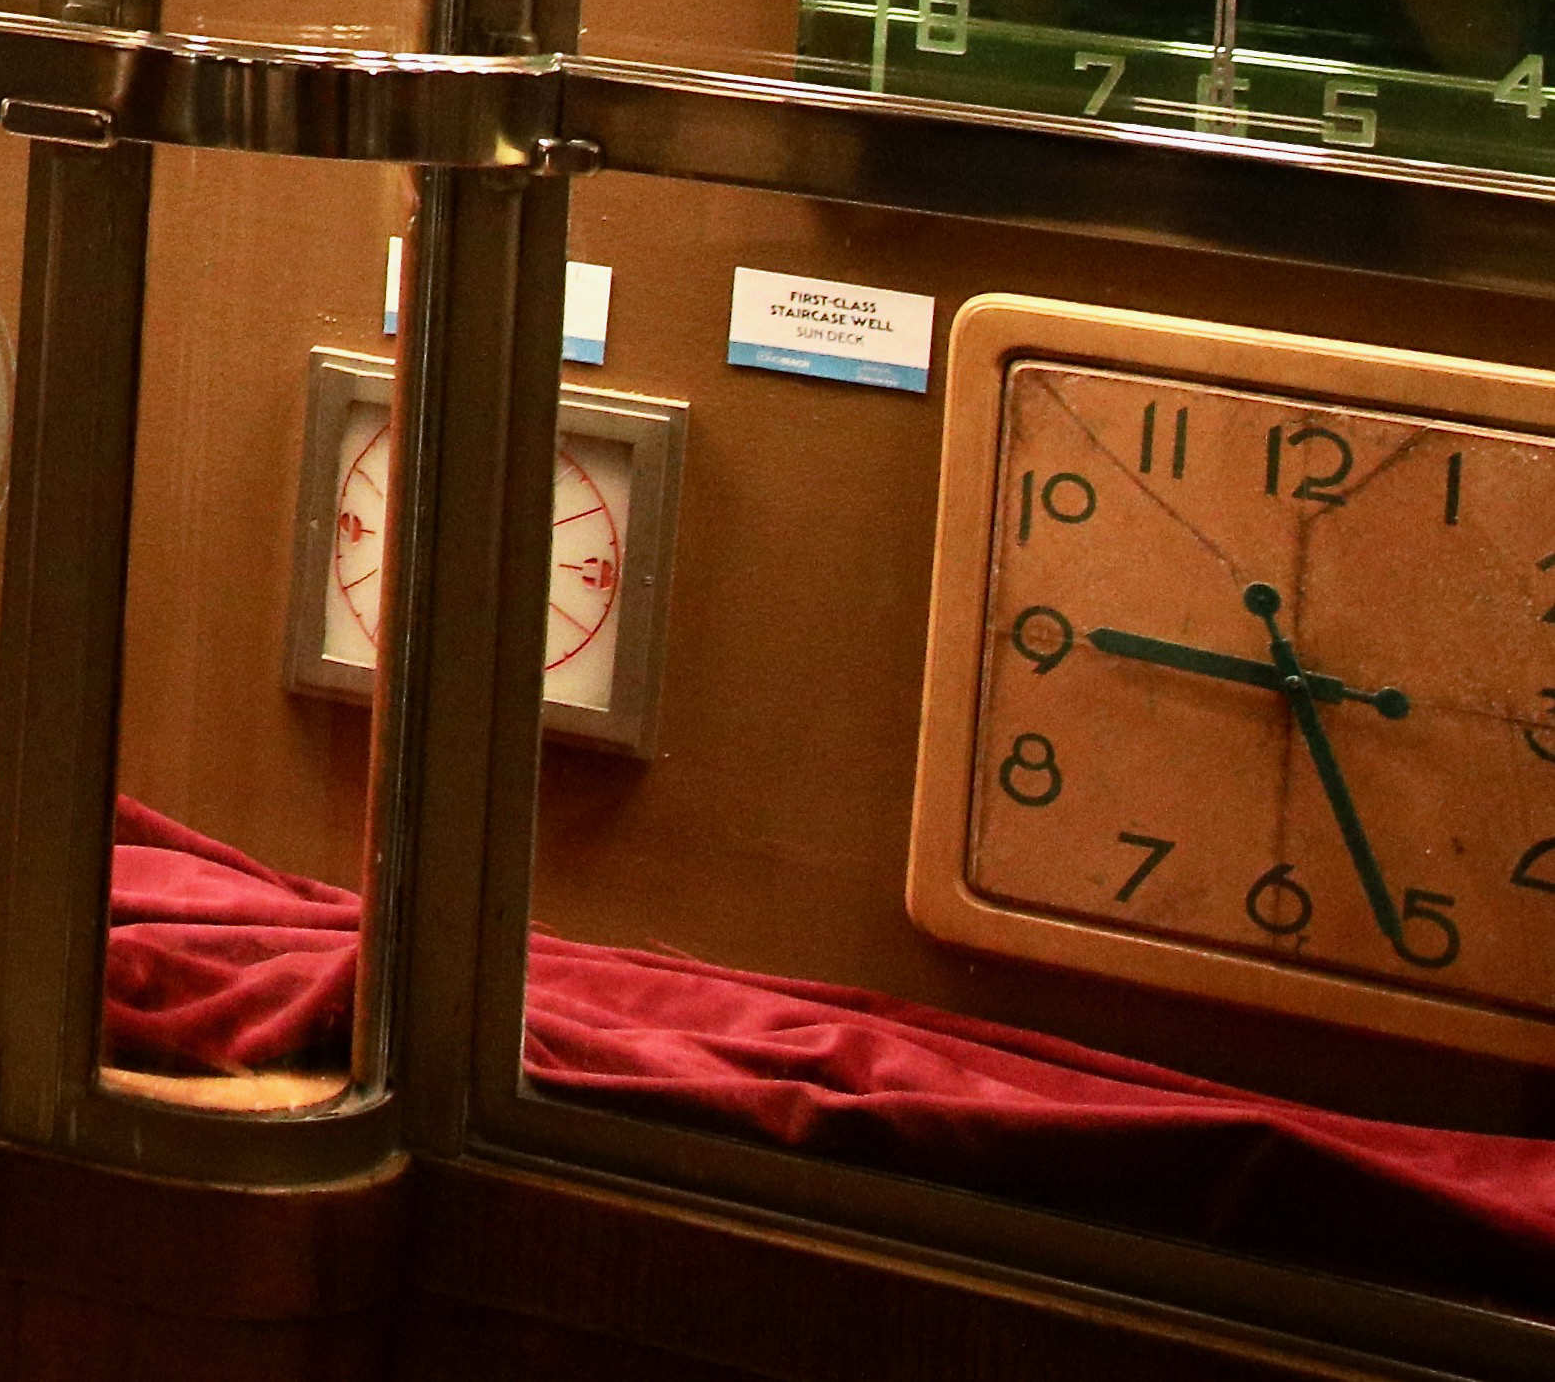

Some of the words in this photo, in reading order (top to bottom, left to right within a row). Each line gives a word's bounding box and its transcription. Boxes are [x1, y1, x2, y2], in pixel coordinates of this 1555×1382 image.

[1072, 51, 1126, 116] 7
[1320, 79, 1379, 149] 5
[1493, 54, 1546, 120] 4
[769, 304, 847, 326] STAIRCASE
[852, 315, 895, 333] WELL
[789, 290, 877, 314] FIRST-CLASS
[828, 330, 866, 347] DECK
[1139, 399, 1189, 481] 11
[1264, 424, 1355, 507] 12
[1015, 469, 1097, 547] 10
[1444, 451, 1463, 526] 1
[1010, 605, 1075, 675] 9
[998, 732, 1064, 808] 8
[1115, 831, 1175, 903] 7
[1245, 862, 1314, 936] 6
[1397, 888, 1462, 969] 5
